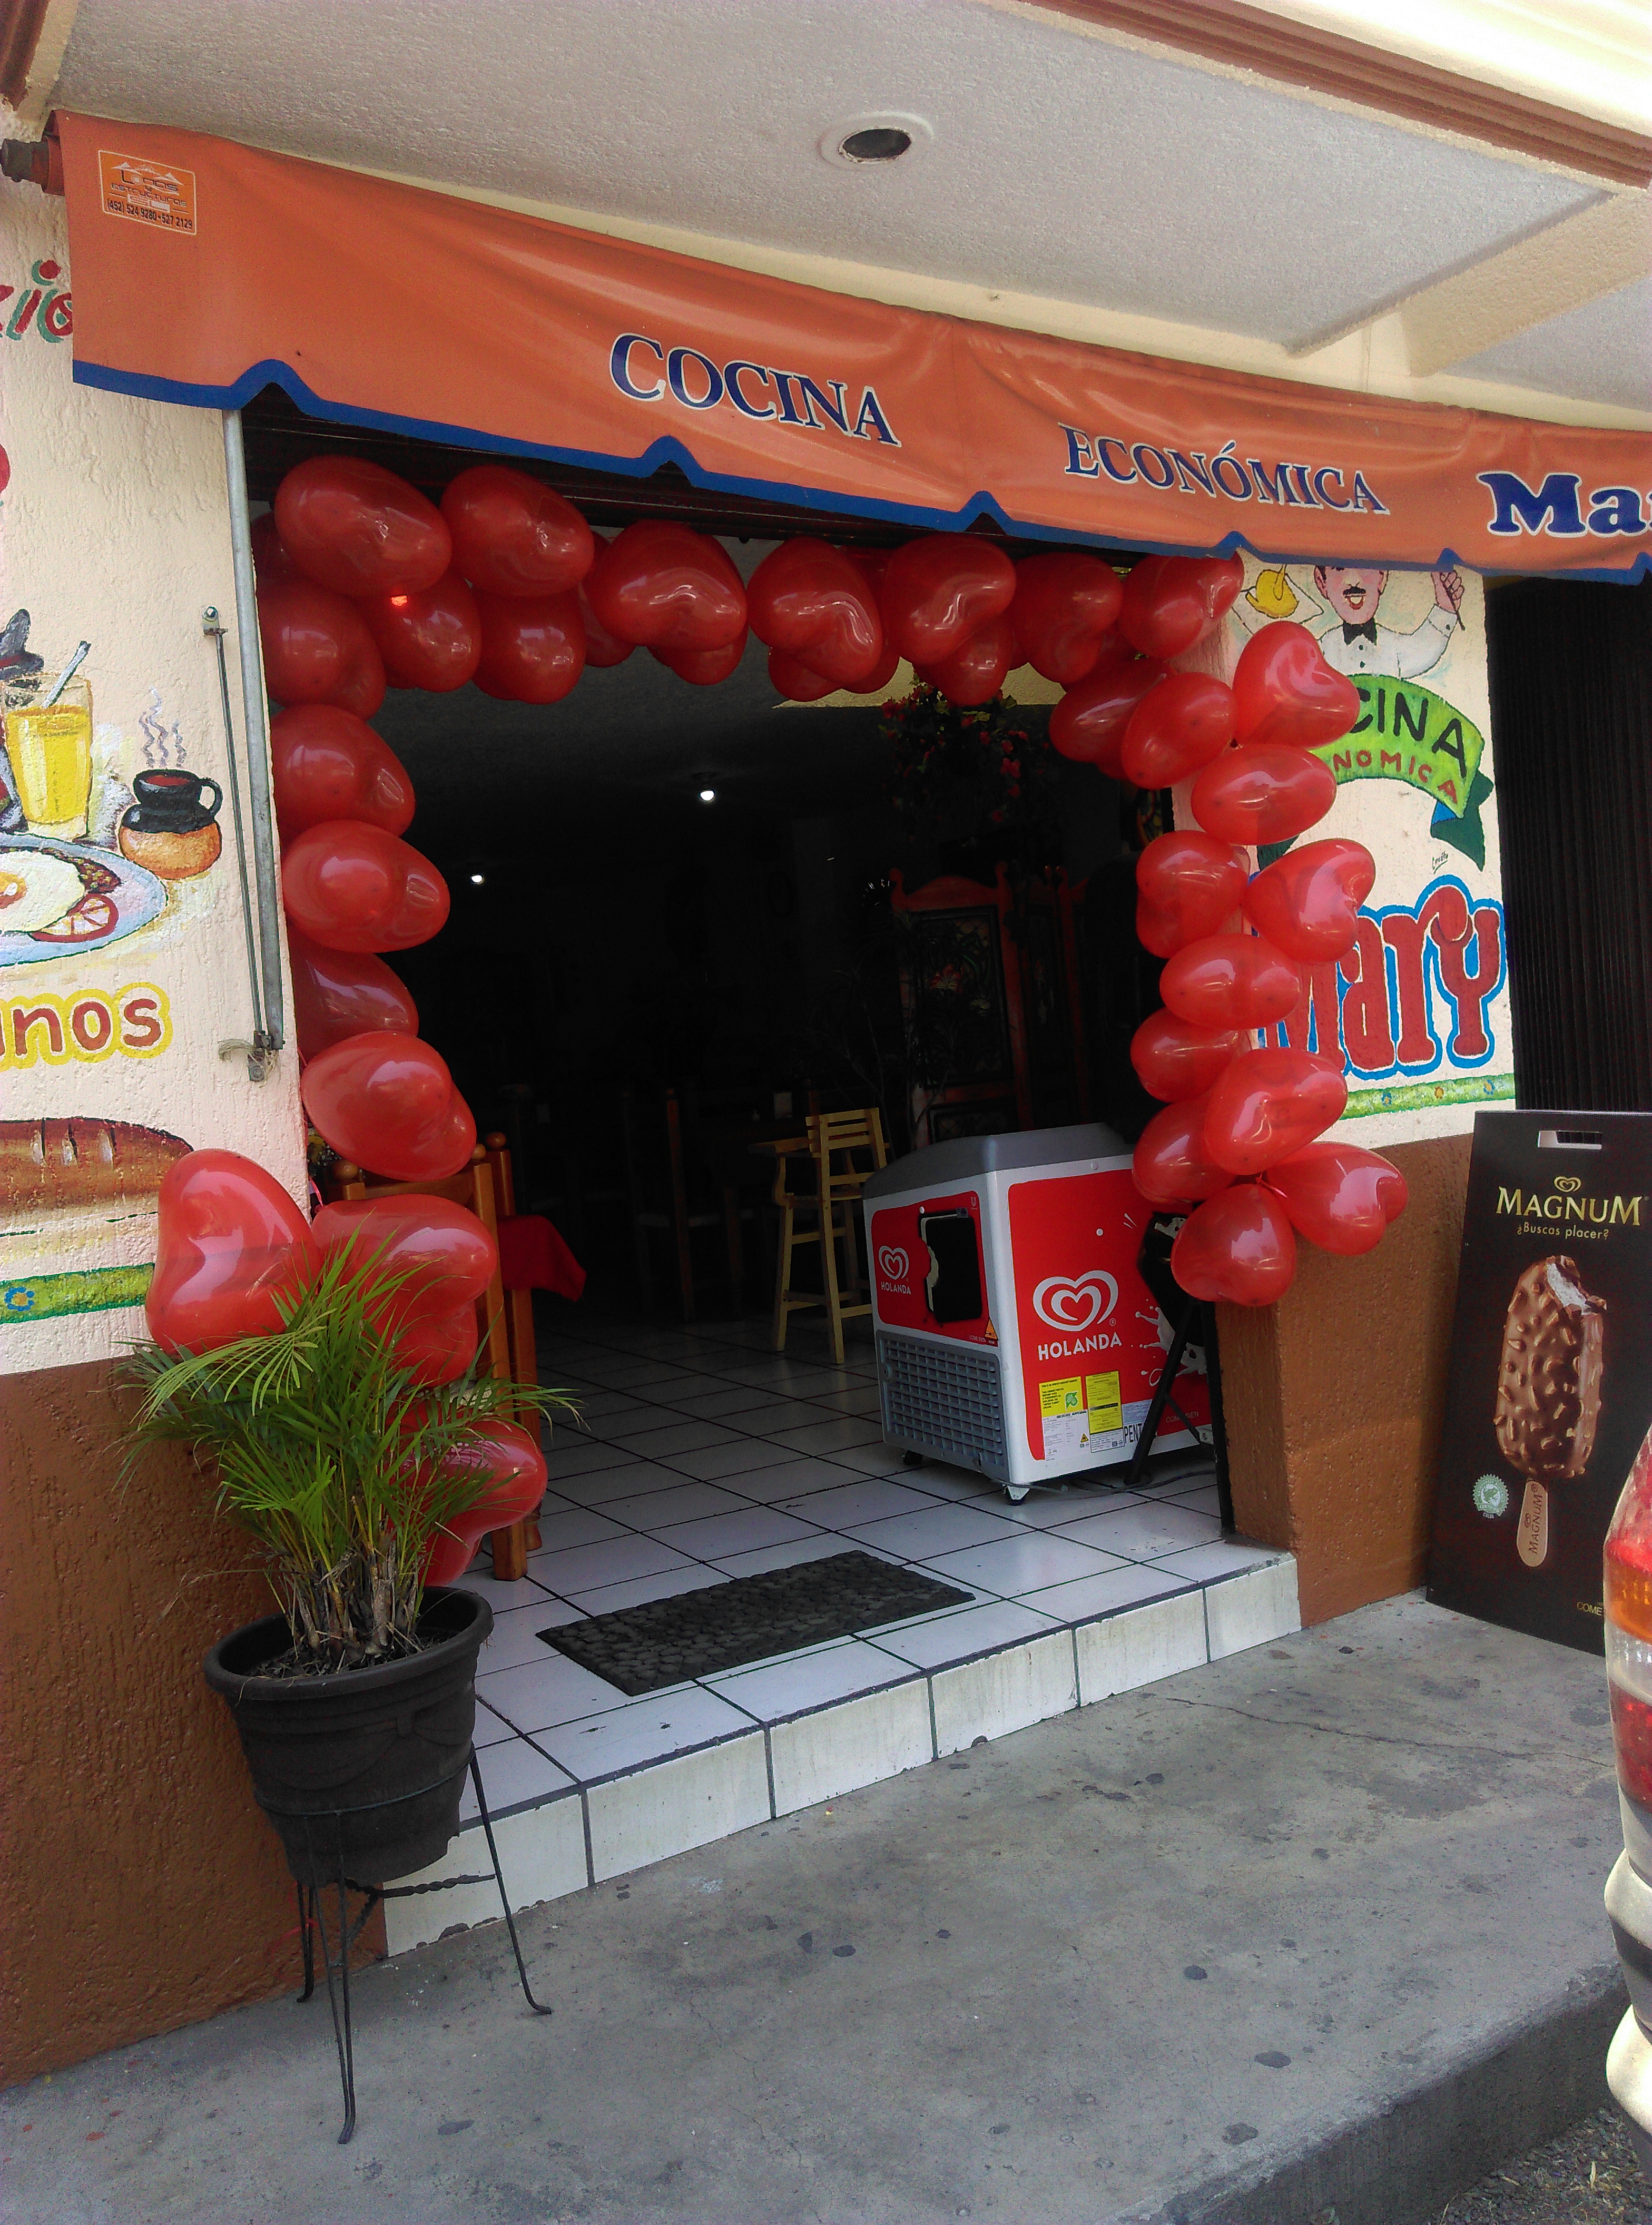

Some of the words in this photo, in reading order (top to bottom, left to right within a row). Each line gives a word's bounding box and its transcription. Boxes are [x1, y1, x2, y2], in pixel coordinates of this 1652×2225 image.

[107, 198, 124, 214] (452)
[126, 203, 139, 216] 524
[175, 216, 193, 230] 2129
[609, 332, 901, 447] COCINA
[1058, 422, 1390, 515] ECONÓMICA
[1476, 470, 1652, 537] Ma
[0, 998, 162, 1056] nos
[1496, 1186, 1643, 1226] MAGNUM
[1517, 1222, 1560, 1236] ¿Buscas
[1565, 1224, 1609, 1240] placer?
[881, 1281, 911, 1295] HOLANDA
[1038, 1332, 1123, 1361] HOLANDA
[1165, 1415, 1181, 1423] COM
[1528, 1494, 1543, 1554] MAGNUM
[1577, 1601, 1602, 1616] COME
